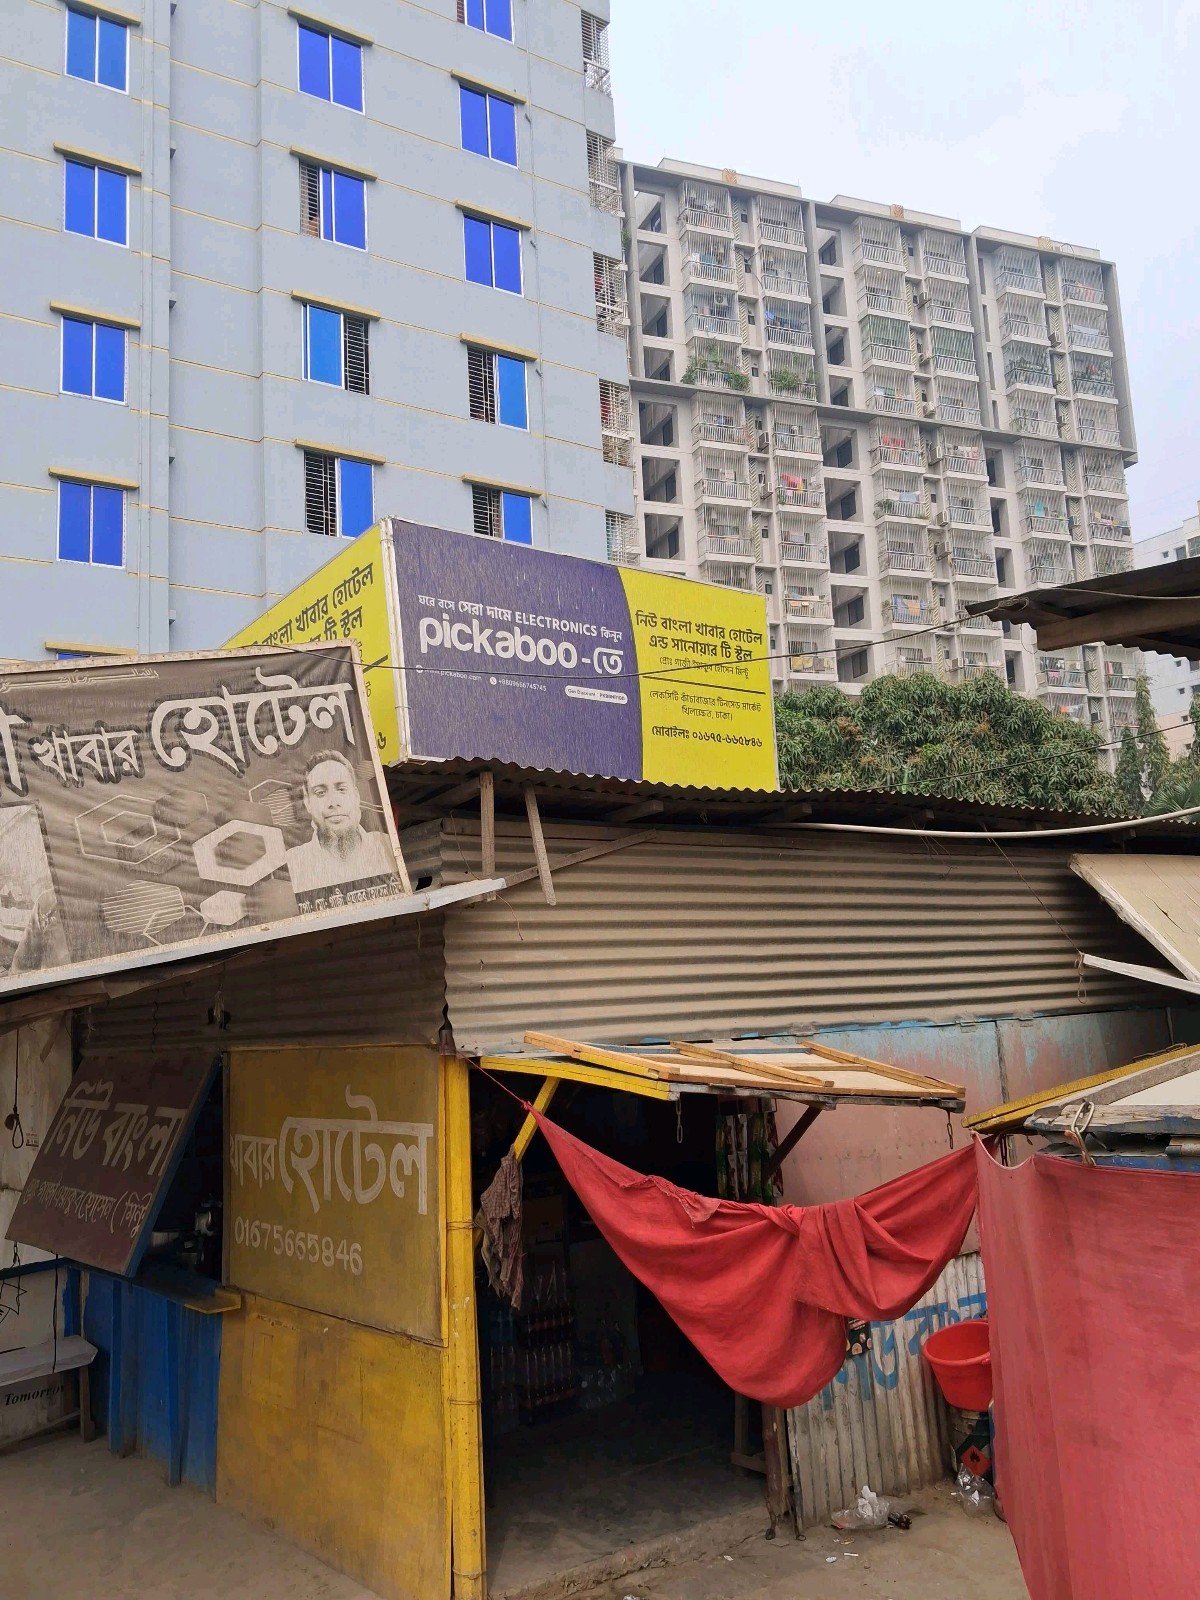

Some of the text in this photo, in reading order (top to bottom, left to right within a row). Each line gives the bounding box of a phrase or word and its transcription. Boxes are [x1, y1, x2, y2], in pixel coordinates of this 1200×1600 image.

[295, 594, 328, 631] খাবার
[332, 563, 373, 609] হোটেল
[418, 595, 622, 642] ঘরে বসে সেরা দামে ELECTRONICS কিনুন
[635, 609, 762, 645] নিউ বাংলা খাবার হোটেল
[649, 634, 668, 649] এন্ড
[671, 637, 717, 657] সানোয়ার
[720, 641, 731, 659] টি
[33, 728, 137, 782] খাবার
[152, 667, 354, 773] হোটেল
[44, 1080, 189, 1176] নিউ বাংলা
[278, 1084, 433, 1215] হোটেল
[235, 1216, 363, 1276] 01675665846
